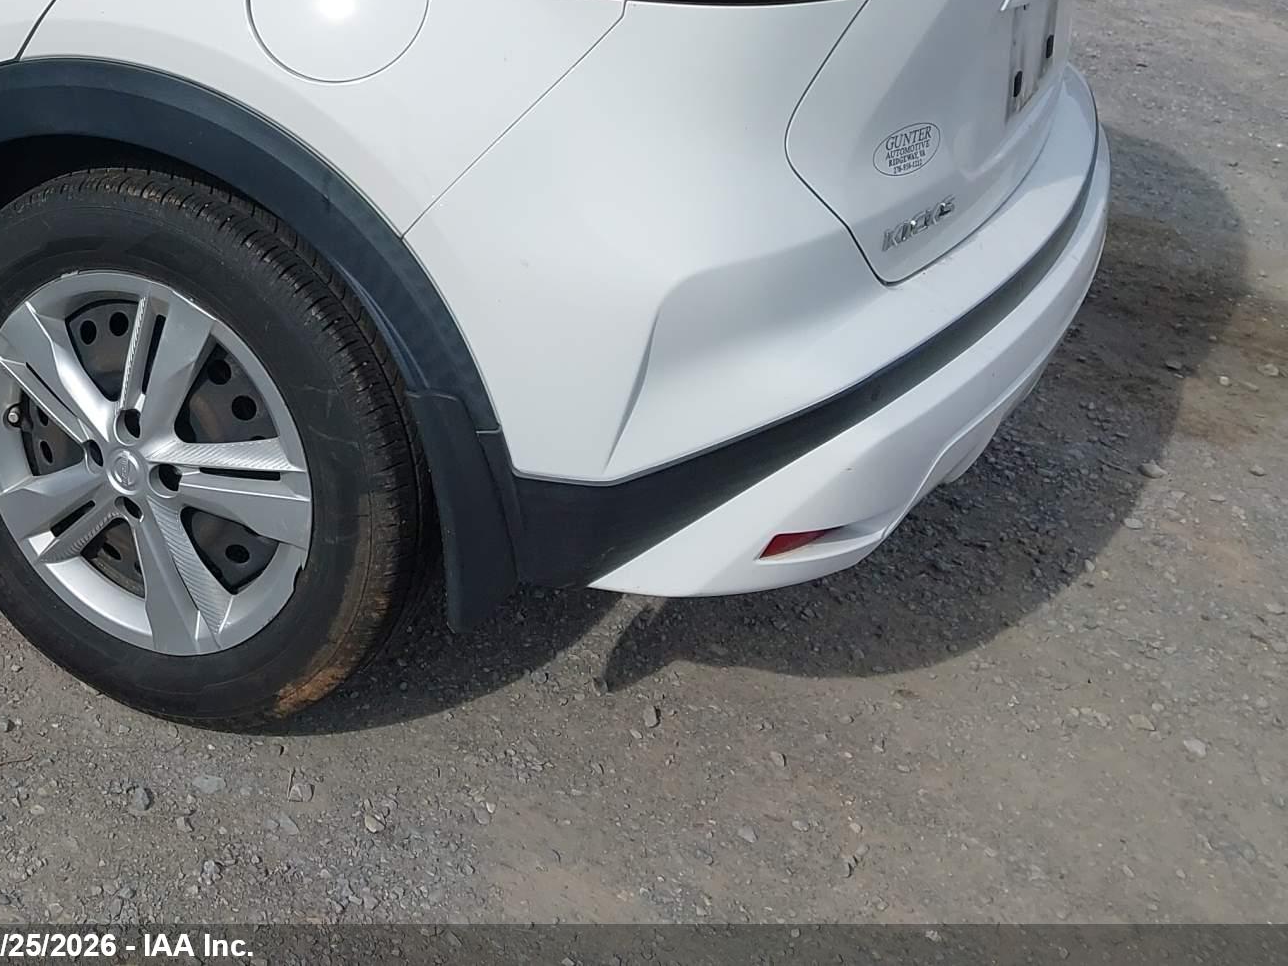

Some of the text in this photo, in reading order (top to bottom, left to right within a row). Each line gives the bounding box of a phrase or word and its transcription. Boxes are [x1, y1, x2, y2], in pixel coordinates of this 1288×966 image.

[885, 125, 932, 151] GUNTER
[885, 139, 931, 160] AUTOMOTIVE
[882, 194, 955, 251] KICKS
